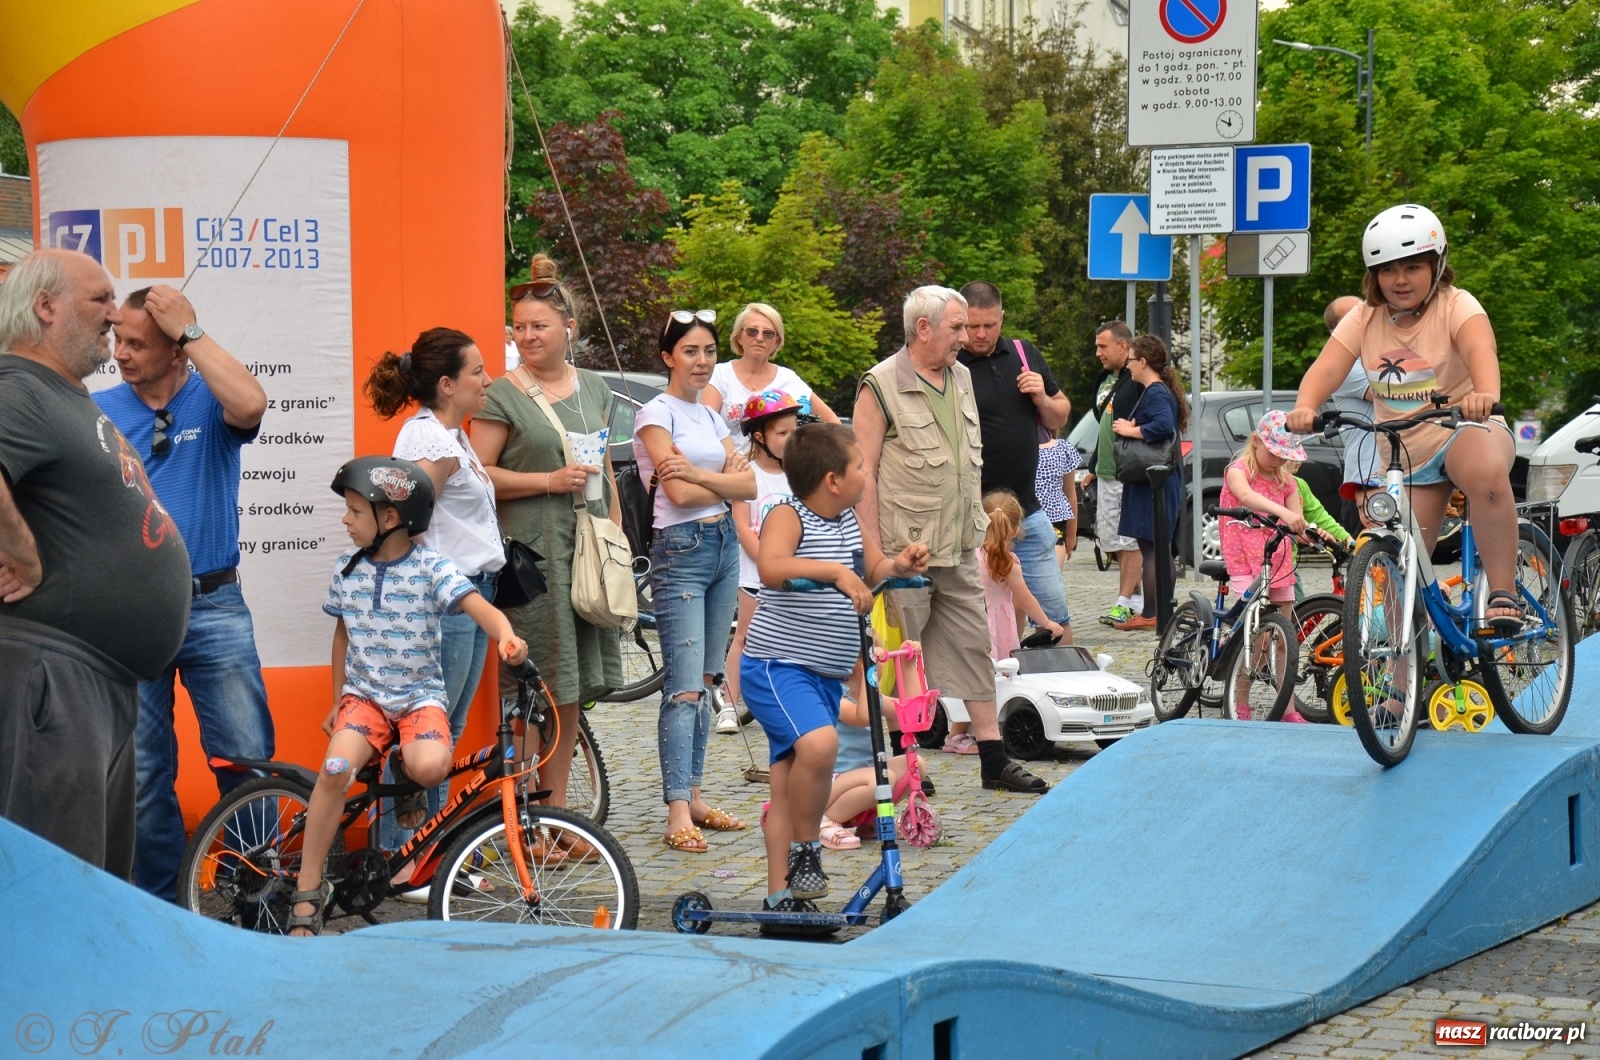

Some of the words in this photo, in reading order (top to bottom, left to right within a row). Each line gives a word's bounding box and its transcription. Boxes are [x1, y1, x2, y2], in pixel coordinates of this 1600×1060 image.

[1143, 50, 1174, 60] Postój
[1179, 48, 1242, 60] ograniczony
[1138, 64, 1151, 72] do
[1164, 62, 1191, 74] godz.
[1196, 62, 1218, 72] pon.
[1233, 60, 1246, 70] pt.
[1154, 75, 1181, 87] godz.
[1174, 87, 1209, 96] sobota
[1153, 101, 1180, 112] godz.
[1246, 155, 1292, 221] P
[264, 218, 298, 243] Cel
[305, 220, 319, 243] 3
[260, 432, 324, 444] środków
[240, 468, 295, 482] ozwoju
[249, 503, 314, 515] środków
